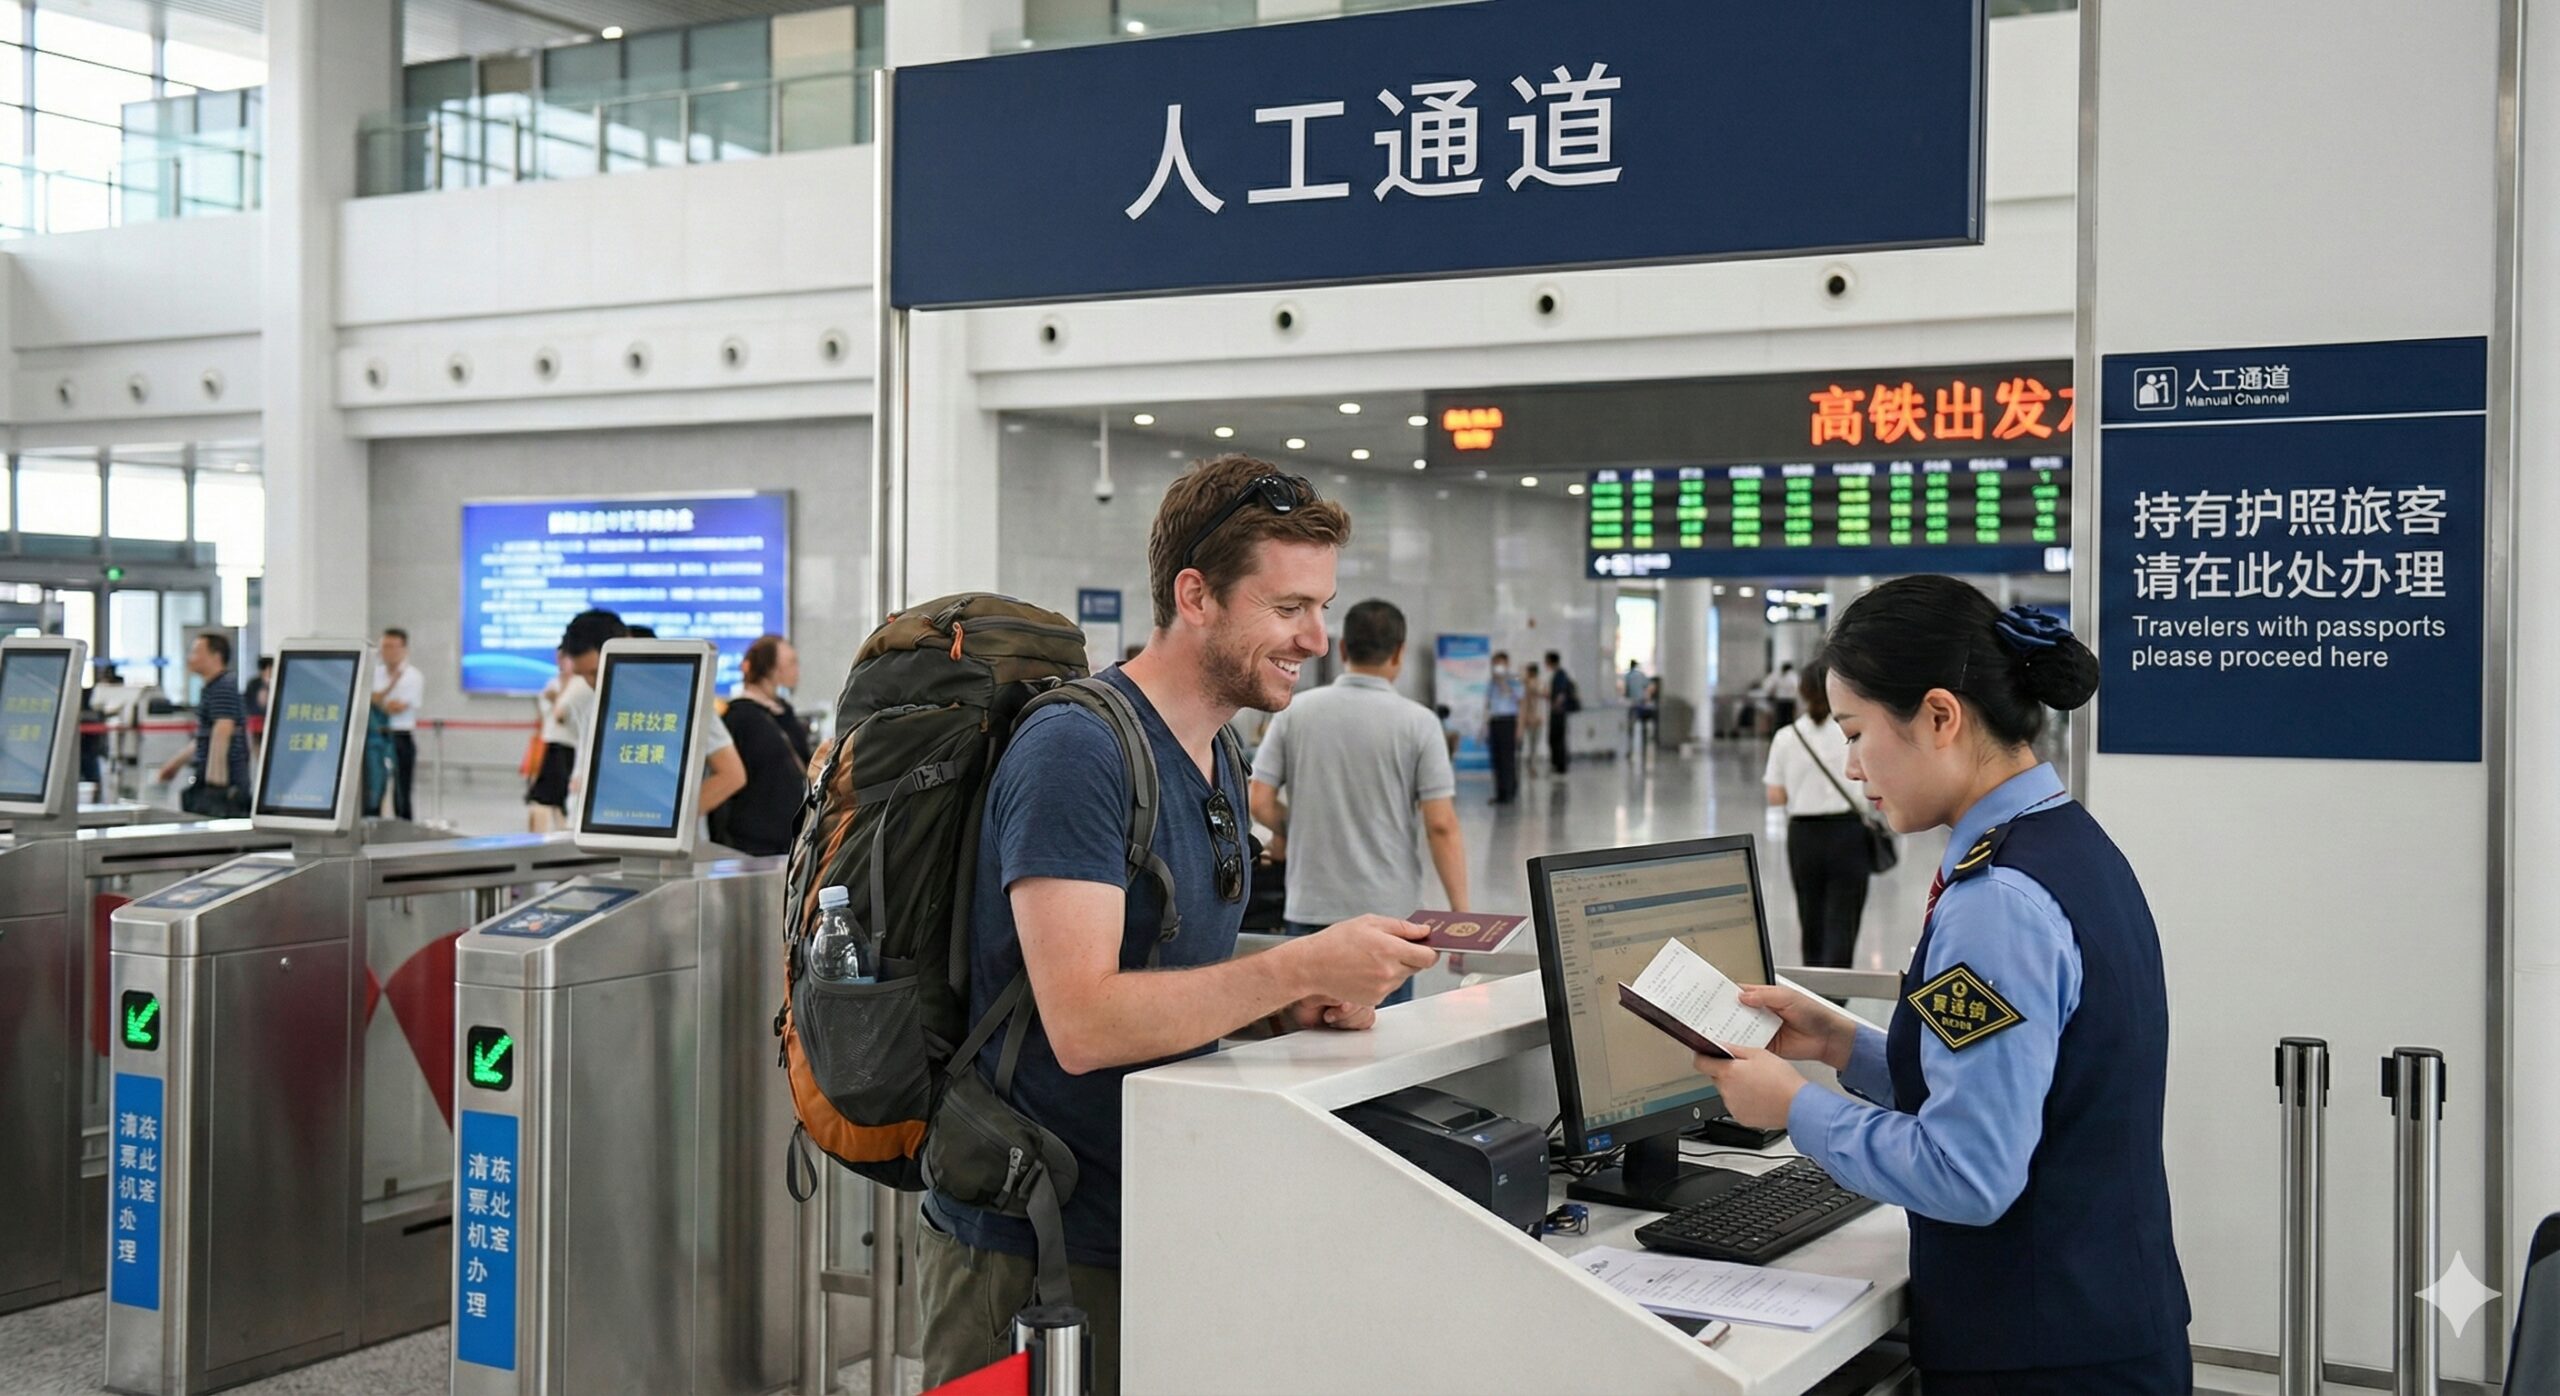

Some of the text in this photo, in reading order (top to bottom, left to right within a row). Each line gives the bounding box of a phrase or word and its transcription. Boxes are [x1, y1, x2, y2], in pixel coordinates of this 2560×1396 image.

[1124, 62, 1623, 221] 人工通道
[2186, 364, 2290, 392] 人工通道
[2185, 391, 2290, 407] Manual Channel
[2133, 485, 2447, 539] 持有护照旅客
[2133, 549, 2446, 600] 请在此处办理
[2132, 615, 2446, 642] Travelers with passports
[2132, 645, 2389, 671] please proceed here
